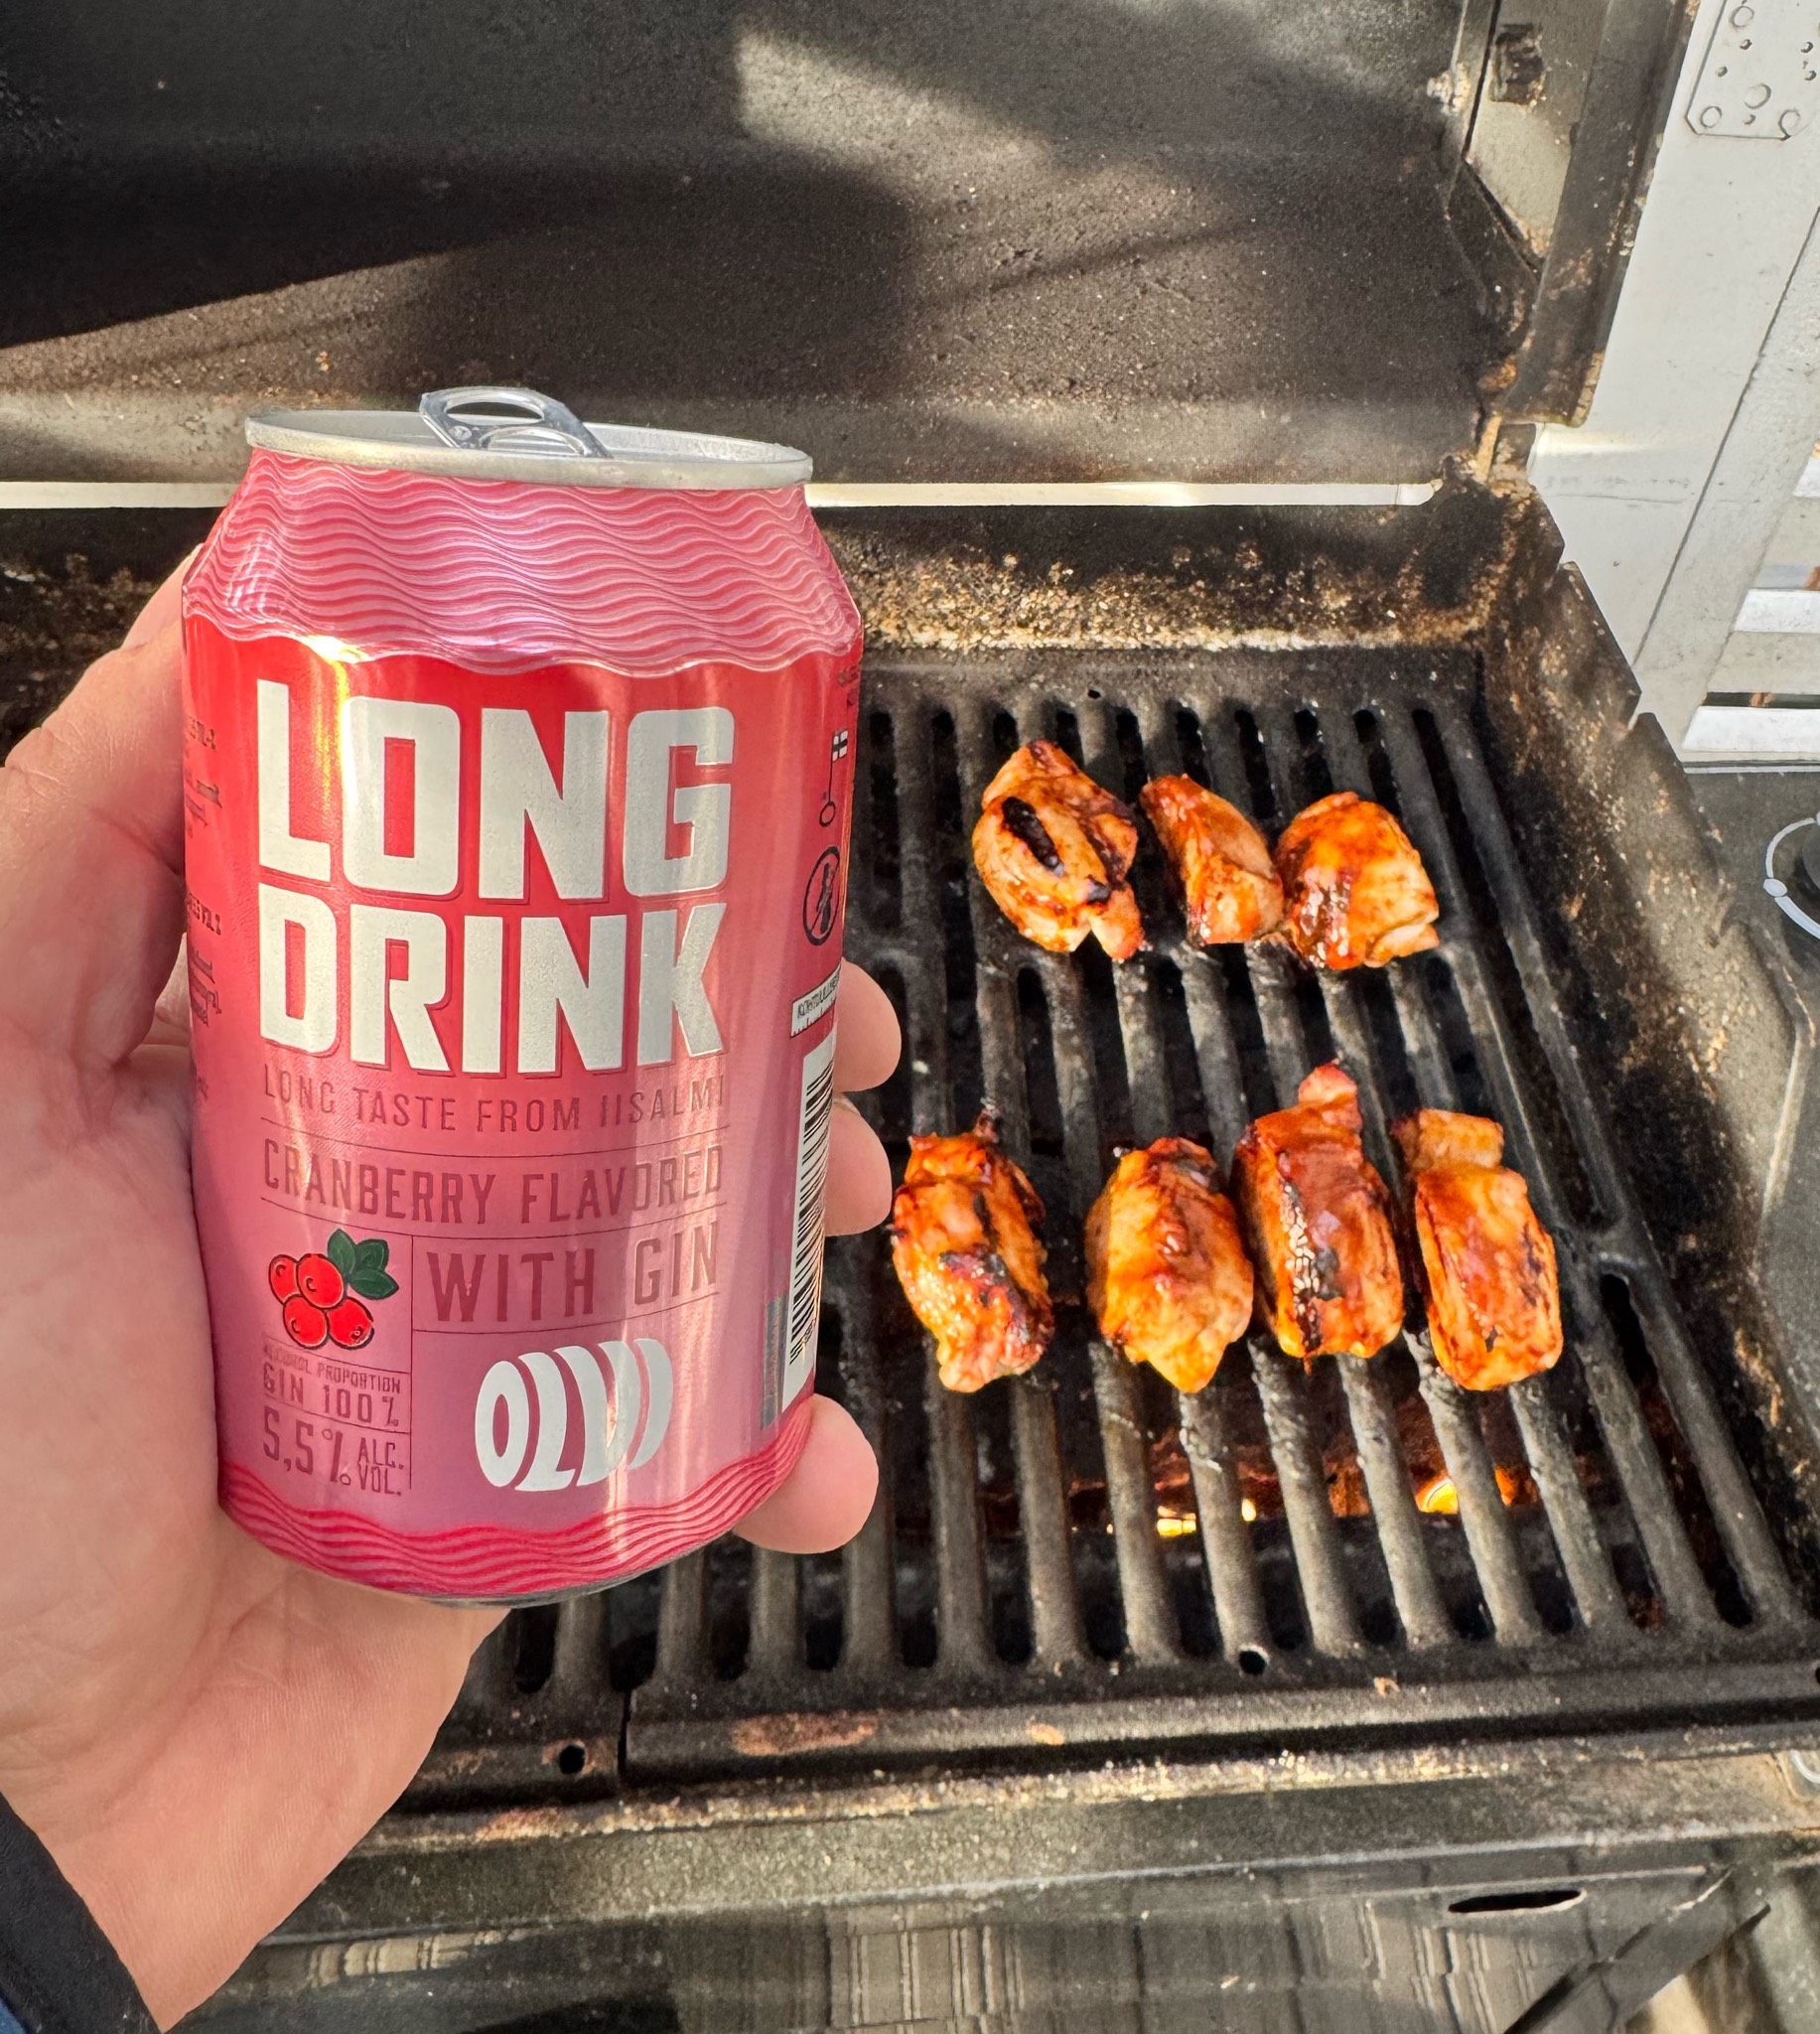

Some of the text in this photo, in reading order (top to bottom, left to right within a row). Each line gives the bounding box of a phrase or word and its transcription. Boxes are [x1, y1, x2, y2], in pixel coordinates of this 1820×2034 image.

[257, 679, 735, 900] LONG
[259, 881, 728, 1074] DRINK
[264, 1064, 335, 1113] LONG
[352, 1088, 456, 1130] TASTE
[477, 1097, 580, 1131] FROM
[600, 1075, 725, 1127] IISALMI
[264, 1138, 723, 1225] CRANBERRY FLAVORED
[427, 1220, 716, 1322] WITH GIN
[263, 1362, 304, 1405] GIN
[318, 1363, 401, 1393] PROPORTION
[357, 1437, 404, 1469] ALC.
[357, 1463, 402, 1496] VOL.
